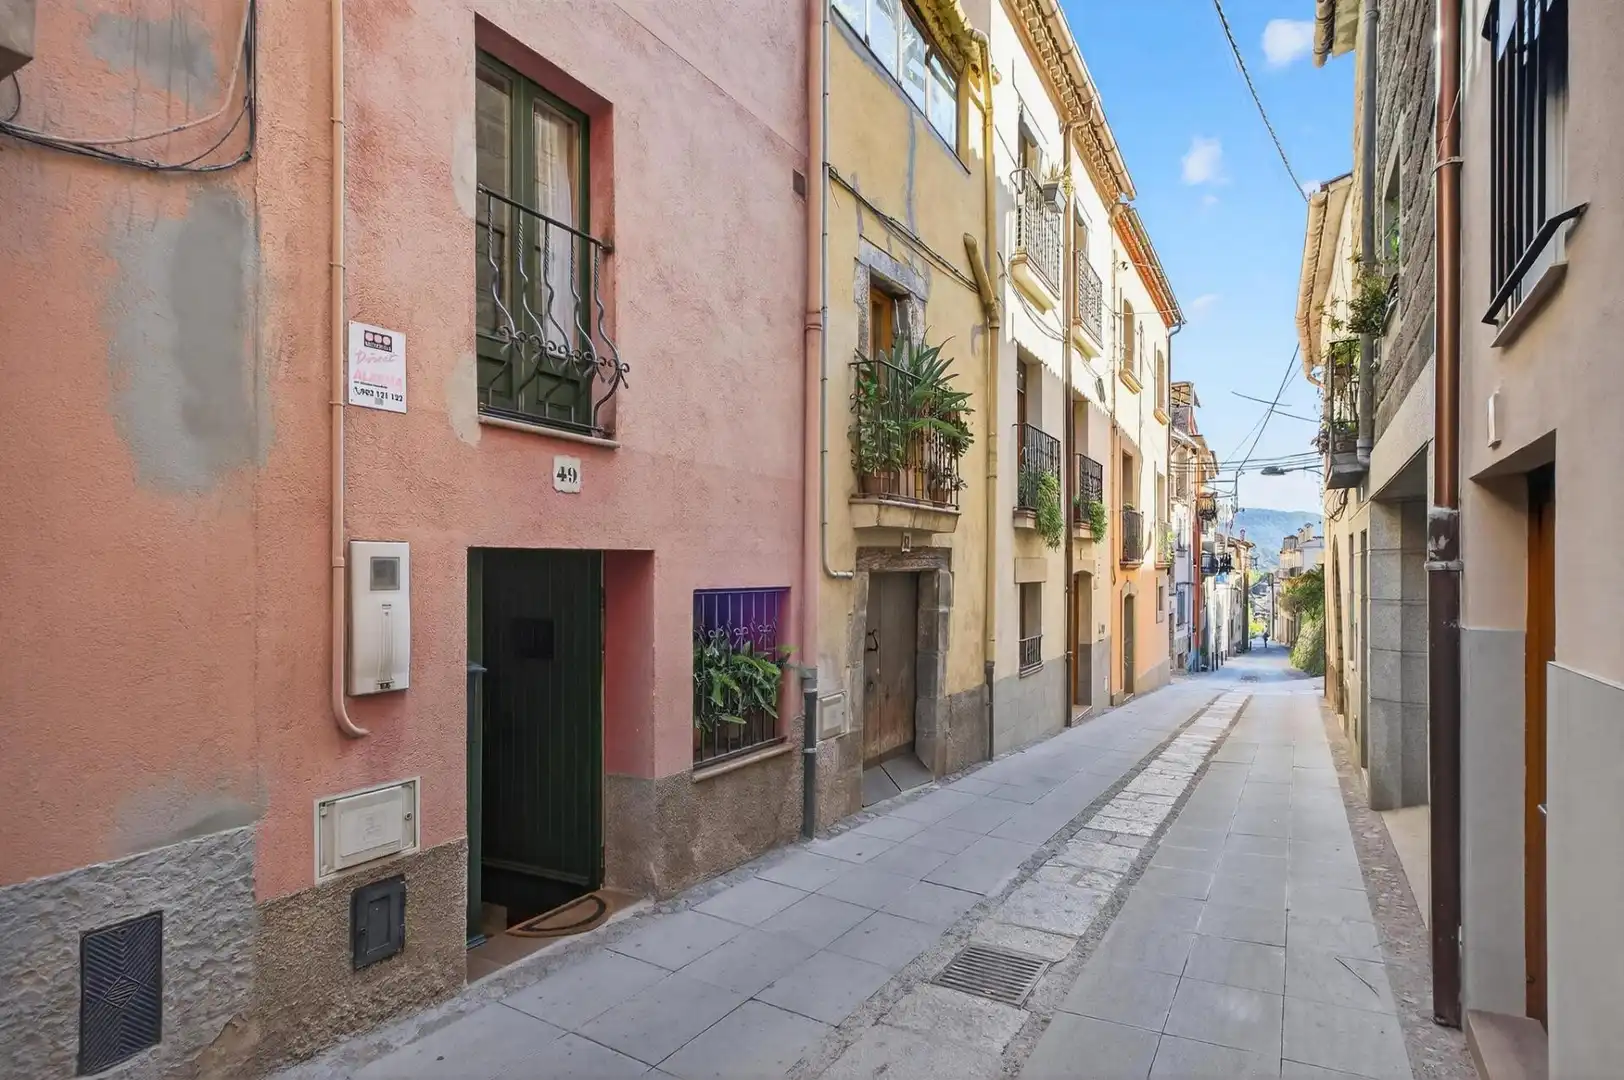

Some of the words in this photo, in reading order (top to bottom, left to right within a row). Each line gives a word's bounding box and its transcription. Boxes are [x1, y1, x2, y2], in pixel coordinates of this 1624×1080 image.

[360, 387, 374, 397] 902
[376, 390, 388, 400] 121
[556, 466, 578, 483] 49
